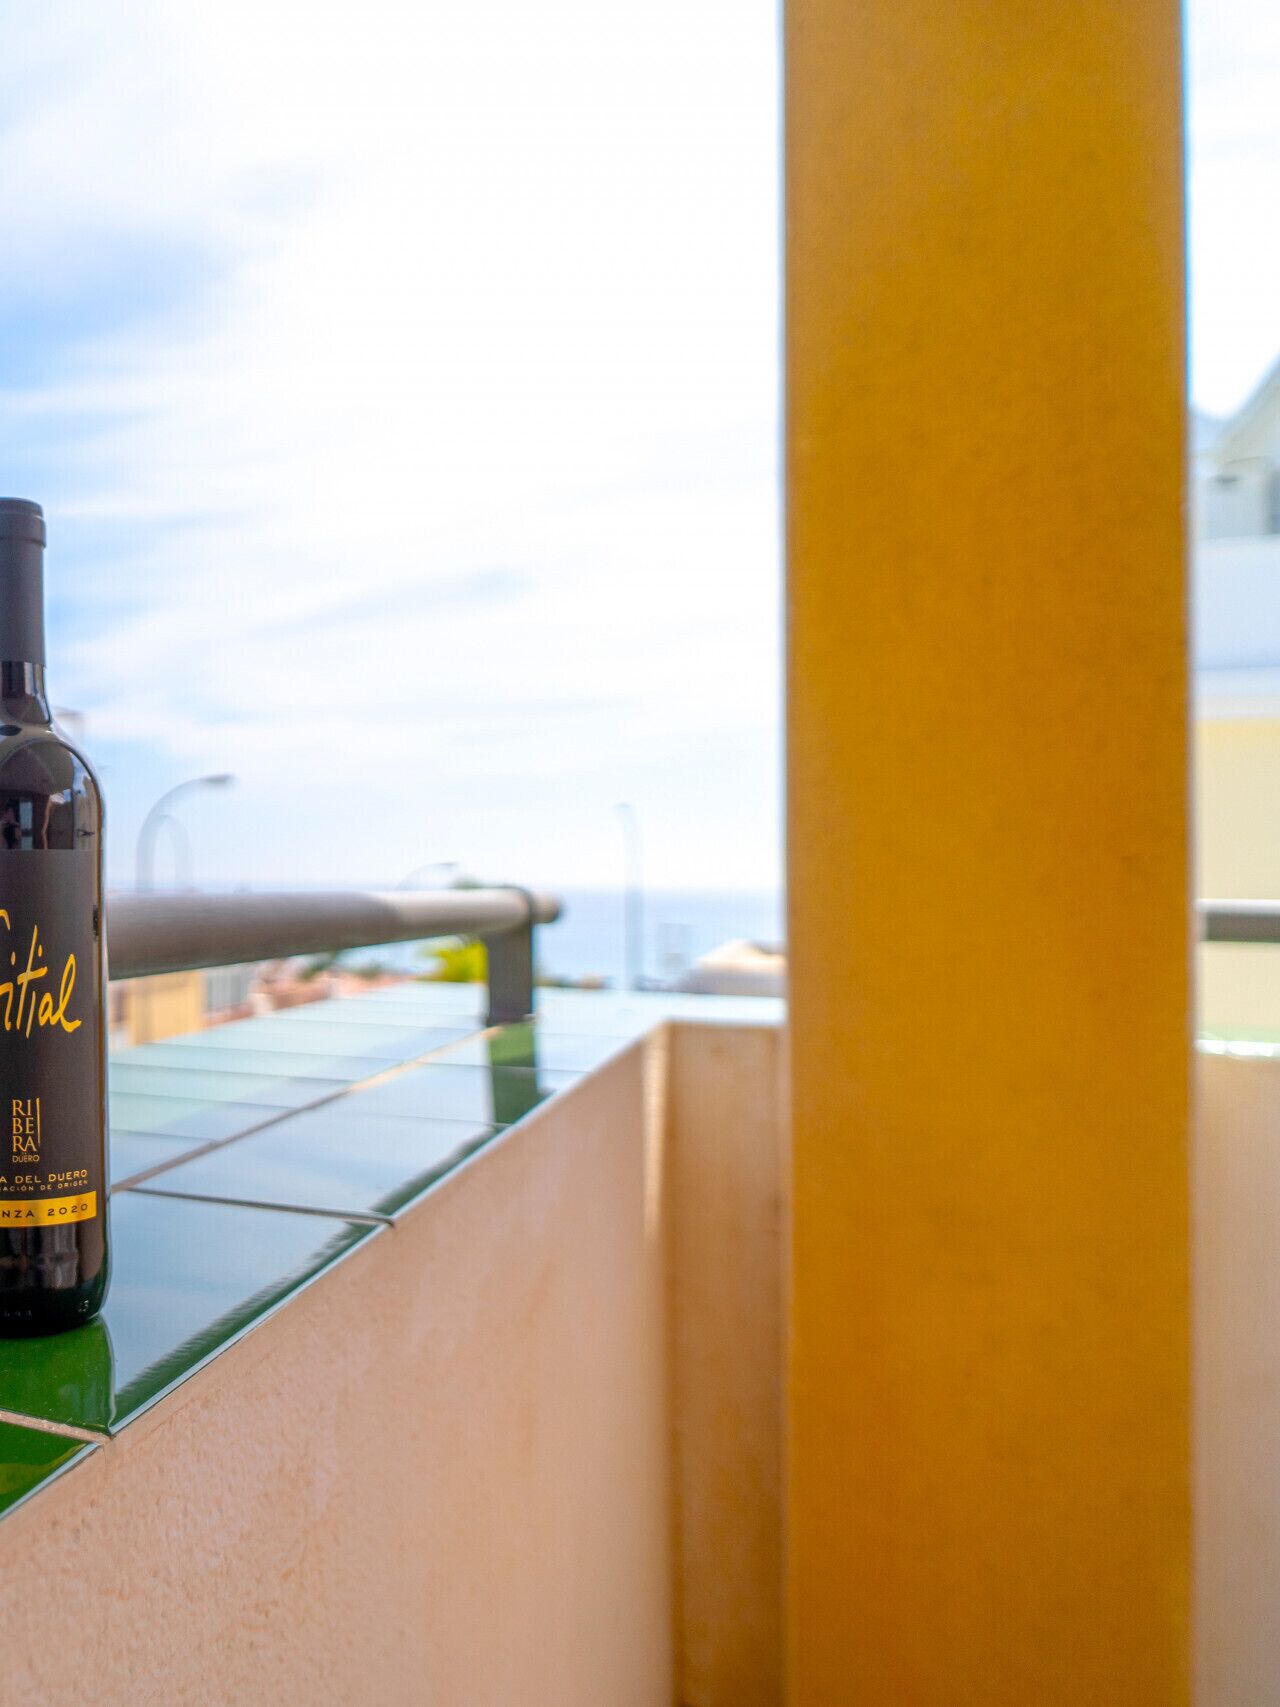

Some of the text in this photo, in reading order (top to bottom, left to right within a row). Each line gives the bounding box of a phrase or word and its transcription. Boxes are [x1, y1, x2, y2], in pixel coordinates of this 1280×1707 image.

[15, 1175, 42, 1184] DEL
[48, 1169, 88, 1183] DUERO
[58, 1180, 88, 1189] ORIGEN
[48, 1203, 88, 1216] 2020
